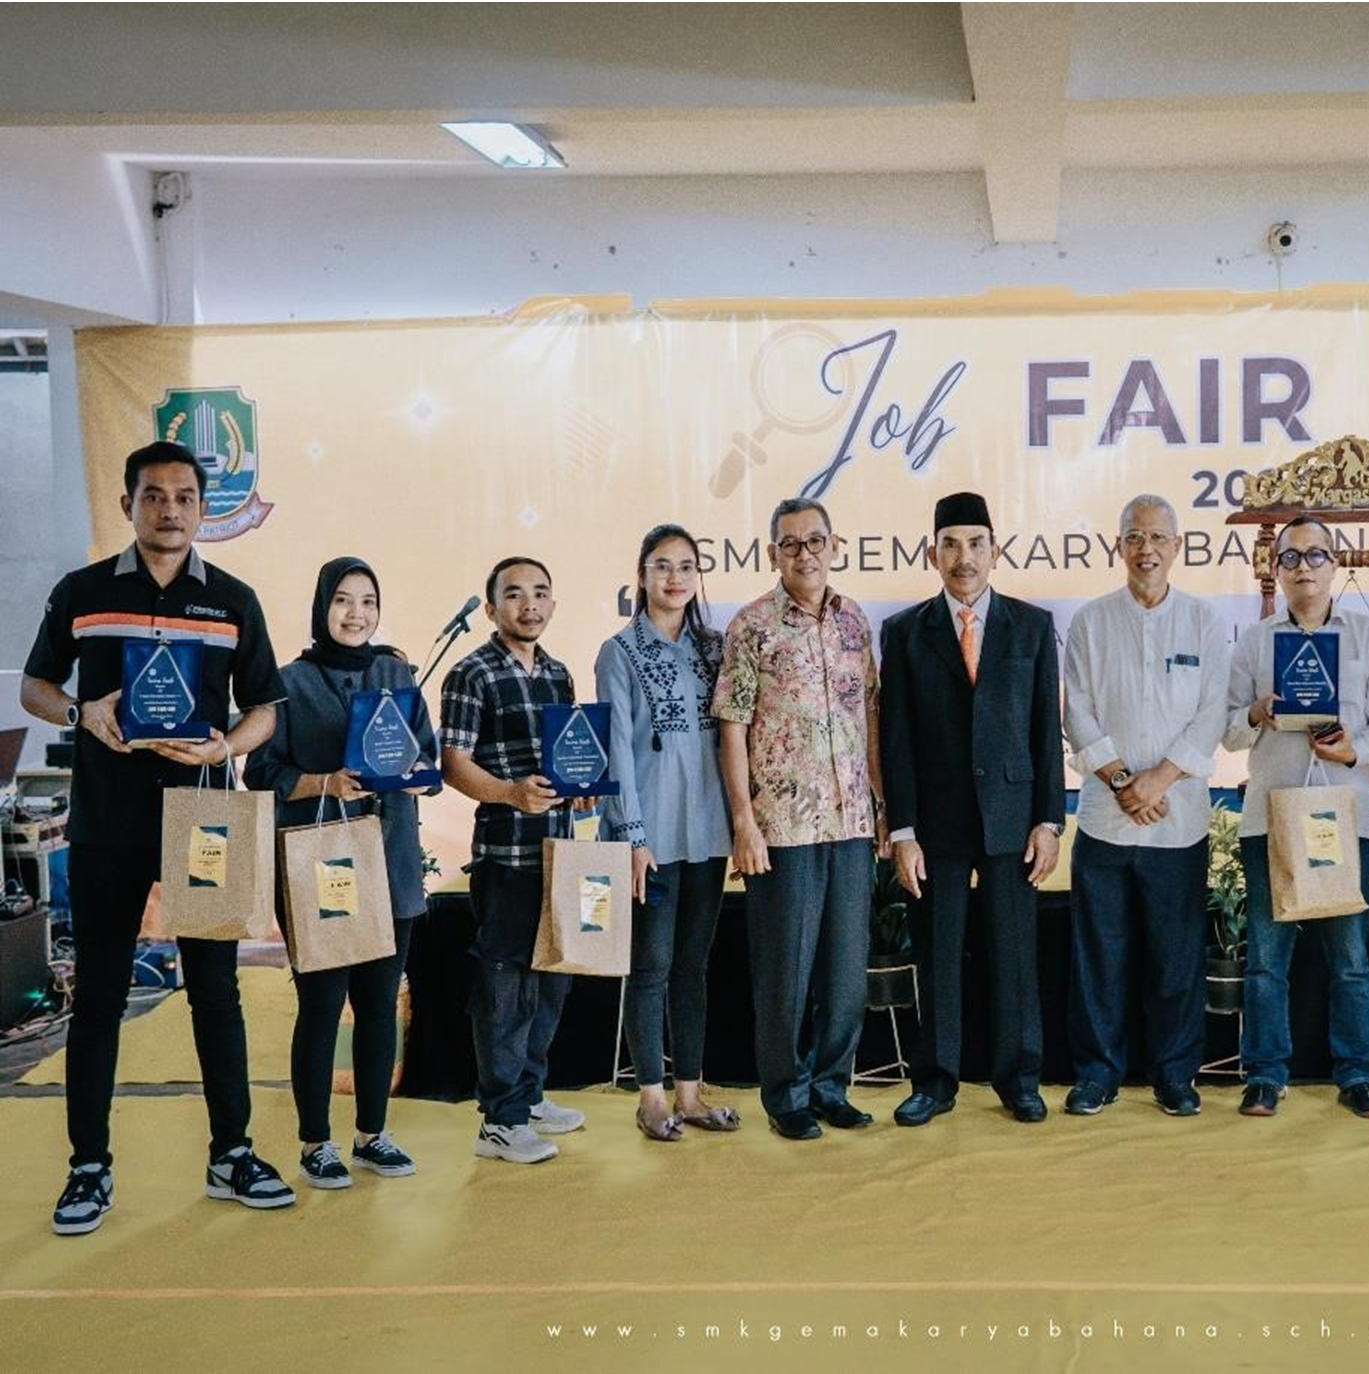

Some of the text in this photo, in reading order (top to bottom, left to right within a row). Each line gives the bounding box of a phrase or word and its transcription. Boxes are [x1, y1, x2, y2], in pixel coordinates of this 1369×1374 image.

[801, 330, 1312, 499] Job FAIR
[695, 537, 778, 572] SM
[829, 536, 929, 572] GEM
[1000, 533, 1118, 569] KARY
